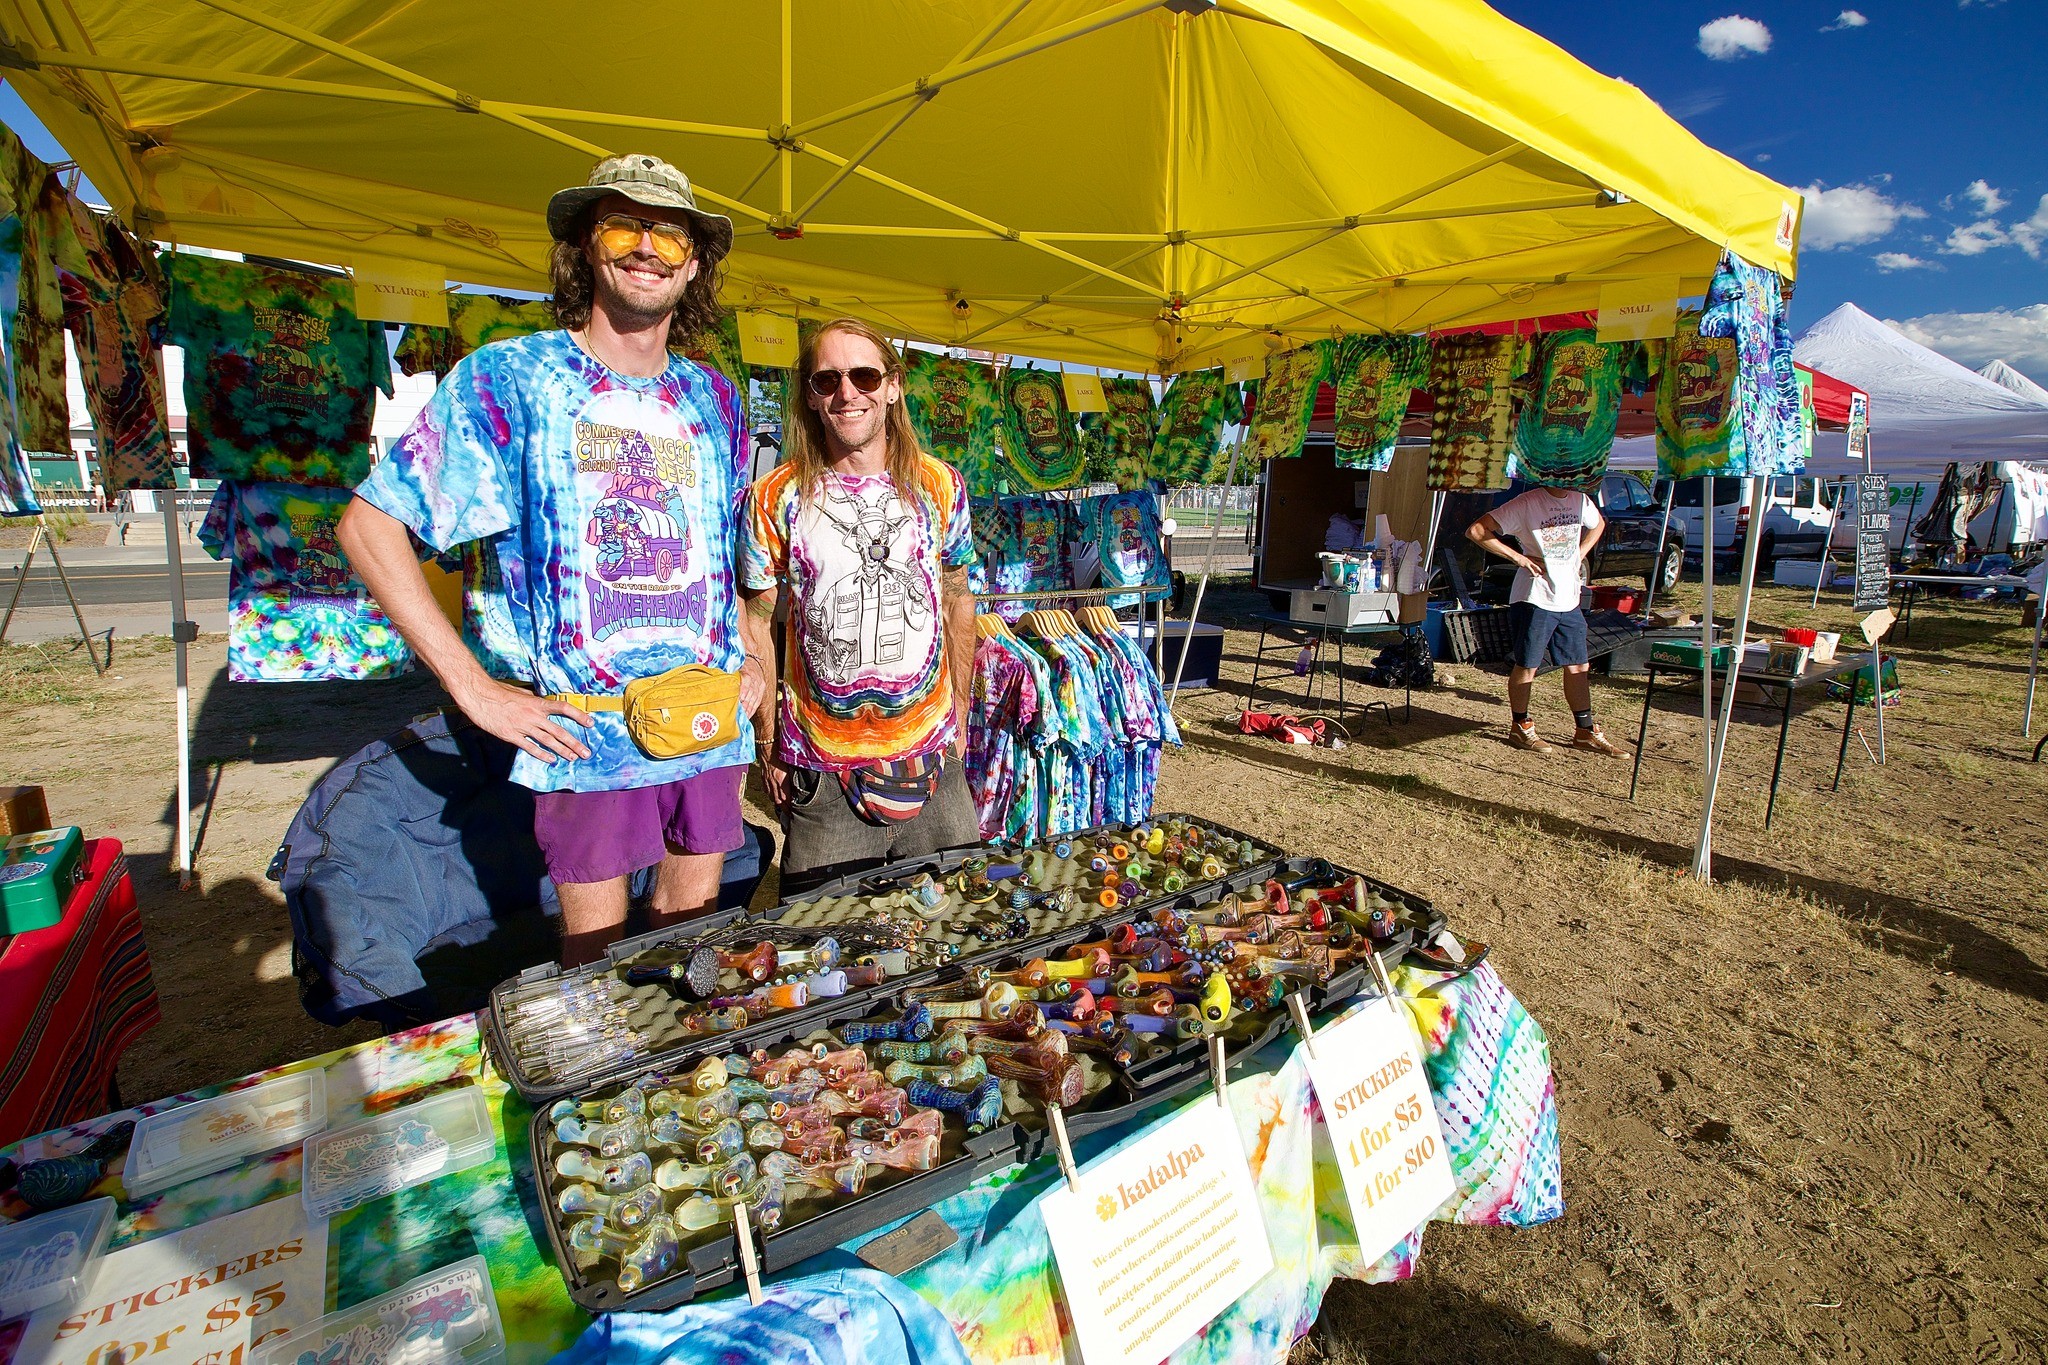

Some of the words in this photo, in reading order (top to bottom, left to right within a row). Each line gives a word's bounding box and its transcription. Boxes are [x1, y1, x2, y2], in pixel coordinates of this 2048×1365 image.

[373, 284, 430, 299] XXLARGE
[254, 315, 281, 326] CITY
[1620, 305, 1653, 315] SMALL
[753, 335, 785, 345] XLARGE
[1231, 355, 1254, 365] MEDIUM
[575, 420, 636, 441] COMMERCE
[576, 438, 621, 462] CITY
[578, 458, 617, 474] COLORADO
[1864, 475, 1885, 491] SIZES
[40, 498, 90, 507] HAPPENS
[1861, 514, 1890, 531] FLAVORS
[627, 583, 647, 591] THE
[647, 584, 670, 592] ROAD
[1334, 1051, 1413, 1119] STICKERS
[1348, 1139, 1361, 1168] 1
[1360, 1121, 1392, 1160] for
[1394, 1093, 1423, 1134] $5
[1117, 1143, 1205, 1211] katalpa
[1361, 1182, 1375, 1209] 4
[1373, 1164, 1403, 1199] for
[1404, 1134, 1436, 1176] $10
[884, 1227, 909, 1243] Hug
[1093, 1254, 1107, 1268] We
[1108, 1243, 1123, 1259] are
[1123, 1232, 1138, 1248] the
[1138, 1211, 1170, 1240] modern
[1170, 1195, 1197, 1216] artists
[1098, 1271, 1121, 1296] place
[1121, 1254, 1148, 1275] where
[1147, 1233, 1175, 1257] artists
[1174, 1215, 1201, 1238] across
[1199, 1191, 1234, 1219] mediums
[1103, 1296, 1121, 1316] and
[1121, 1280, 1146, 1302] styles
[1145, 1266, 1162, 1284] will
[1161, 1249, 1184, 1273] distill
[1184, 1237, 1202, 1256] their
[1118, 1301, 1151, 1332] creative
[1151, 1273, 1191, 1306] directions
[1190, 1260, 1207, 1277] into
[1211, 1235, 1237, 1260] unique
[54, 1237, 304, 1342] STICKERS
[84, 1325, 188, 1365] for
[203, 1280, 287, 1336] $5
[1124, 1304, 1183, 1355] amalgamation
[1181, 1292, 1193, 1308] of
[1190, 1285, 1204, 1301] art
[1203, 1273, 1219, 1291] and
